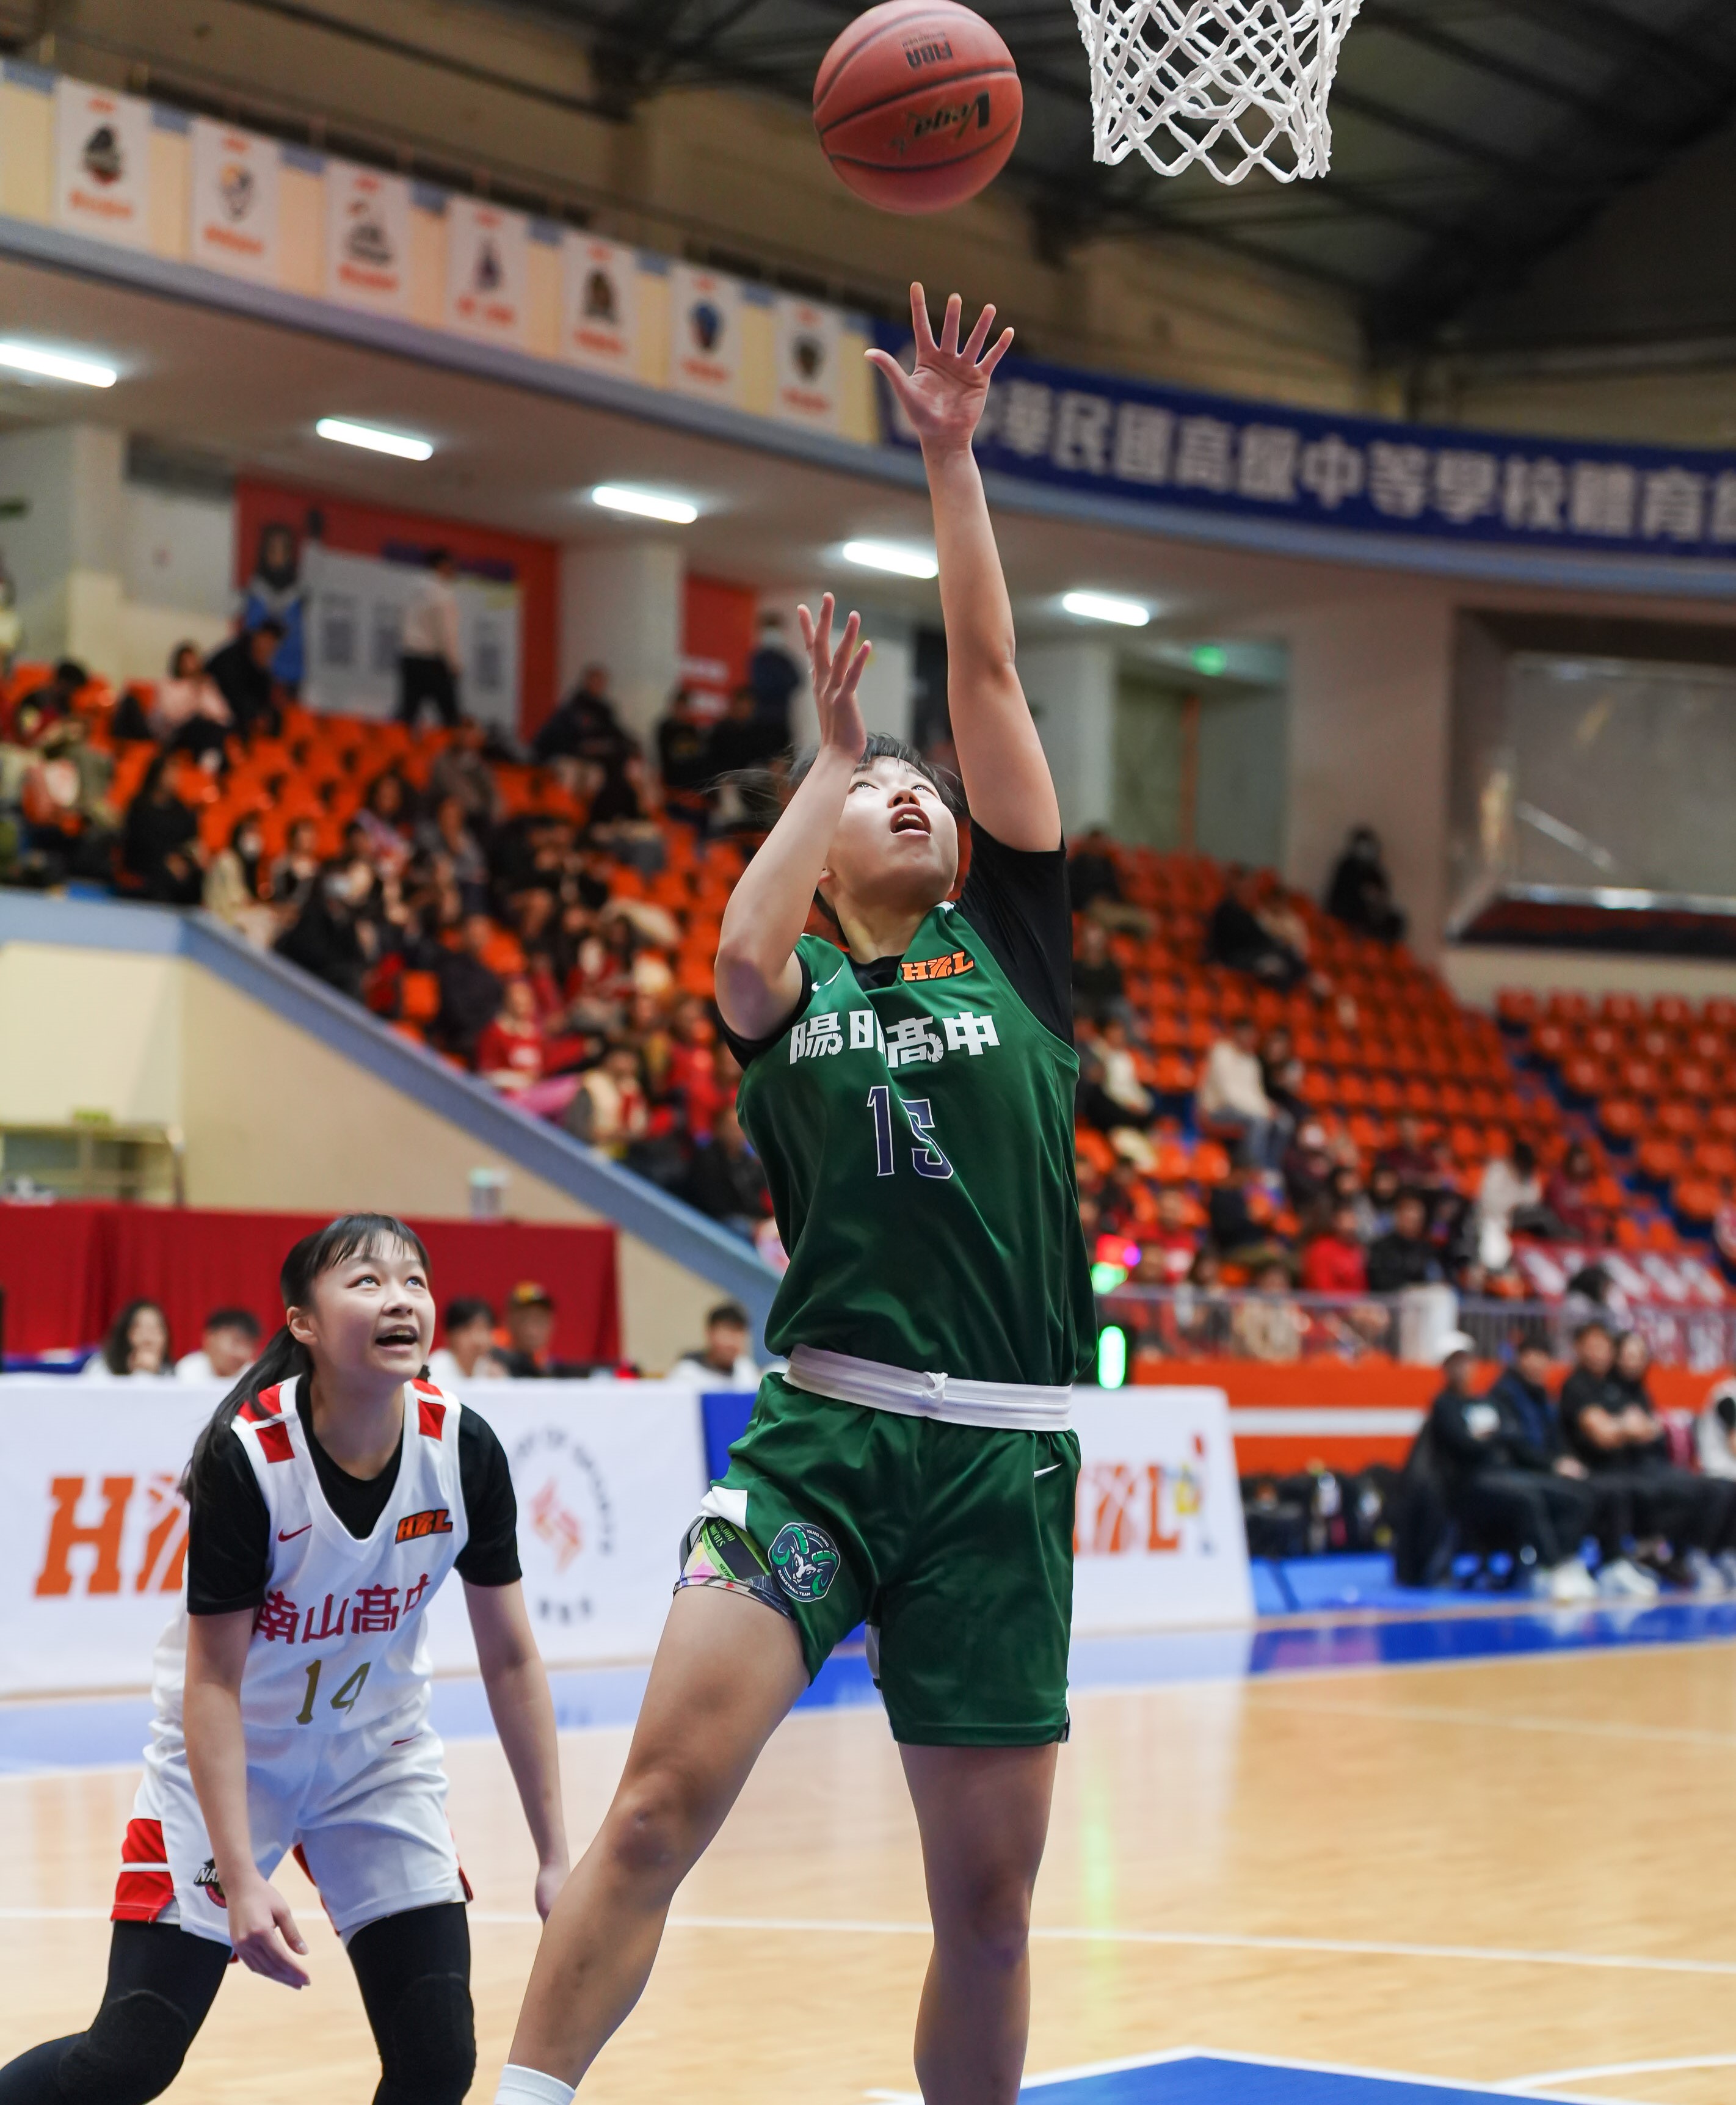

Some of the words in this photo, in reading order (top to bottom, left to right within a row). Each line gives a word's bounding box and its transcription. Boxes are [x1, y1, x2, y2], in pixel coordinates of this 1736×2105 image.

[900, 951, 974, 982] HBL
[866, 1085, 954, 1179] 15
[395, 1508, 453, 1545] HBL
[806, 1529, 819, 1538] YANG
[819, 1535, 830, 1548] MING
[777, 1569, 799, 1595] BASKETBALL
[296, 1659, 371, 1725] 14
[194, 1867, 219, 1883] NA
